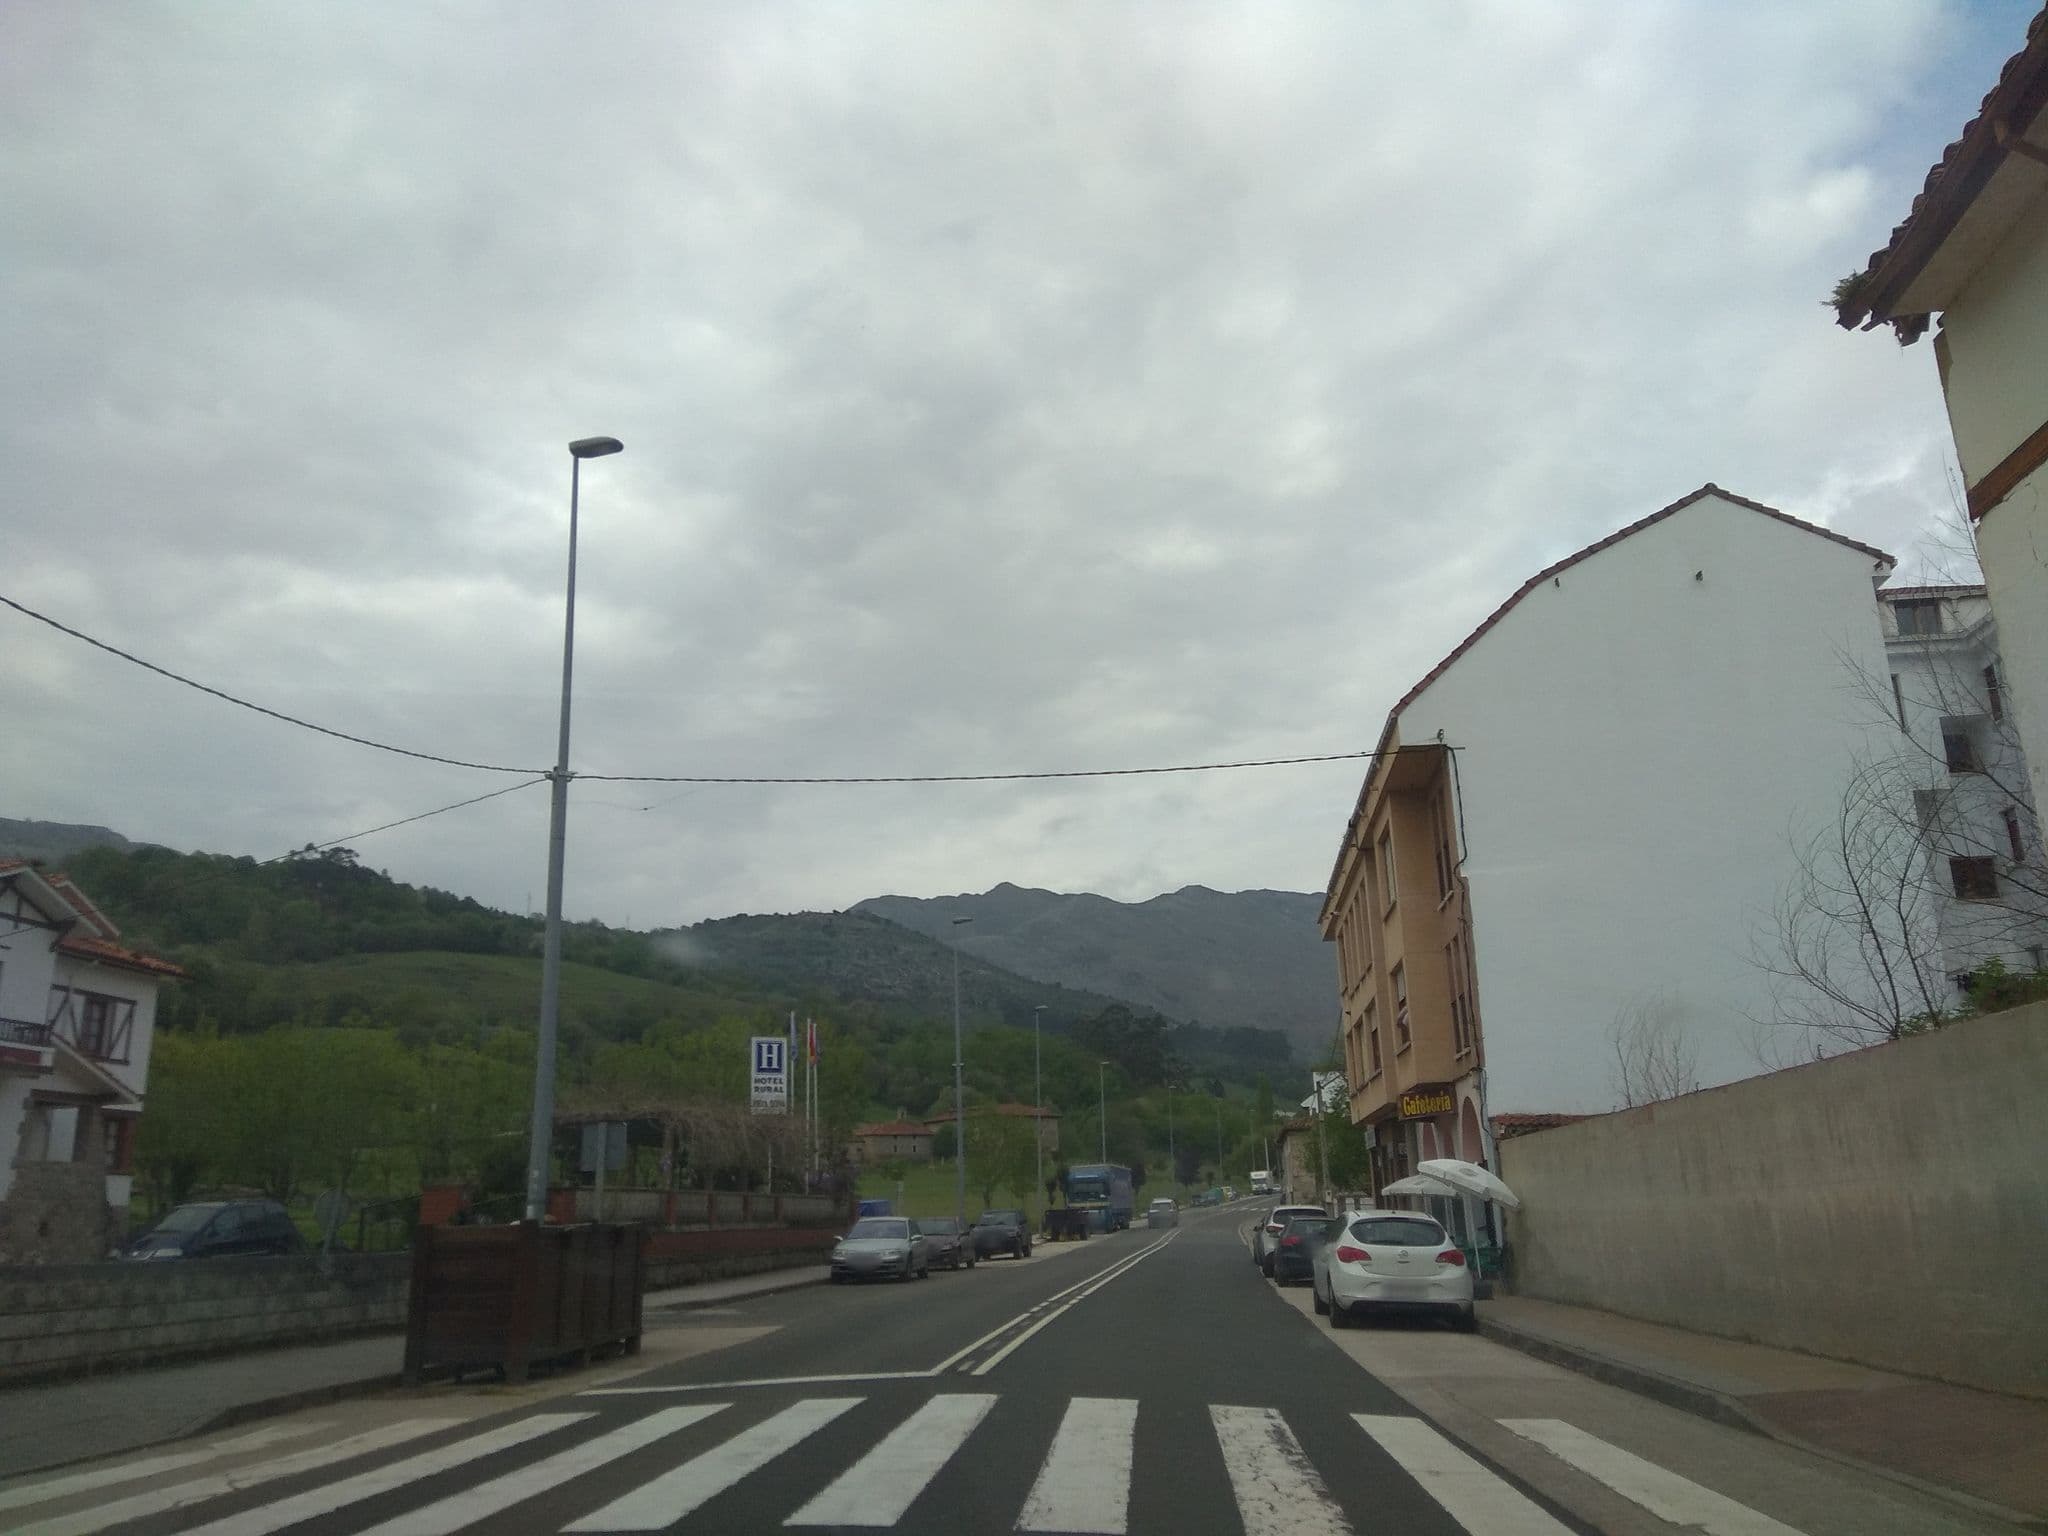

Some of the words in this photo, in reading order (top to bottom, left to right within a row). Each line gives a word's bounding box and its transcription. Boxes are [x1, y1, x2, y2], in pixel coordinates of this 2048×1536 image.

[759, 1043, 780, 1069] H
[754, 1077, 783, 1085] HOTEL
[754, 1086, 784, 1094] RURAL
